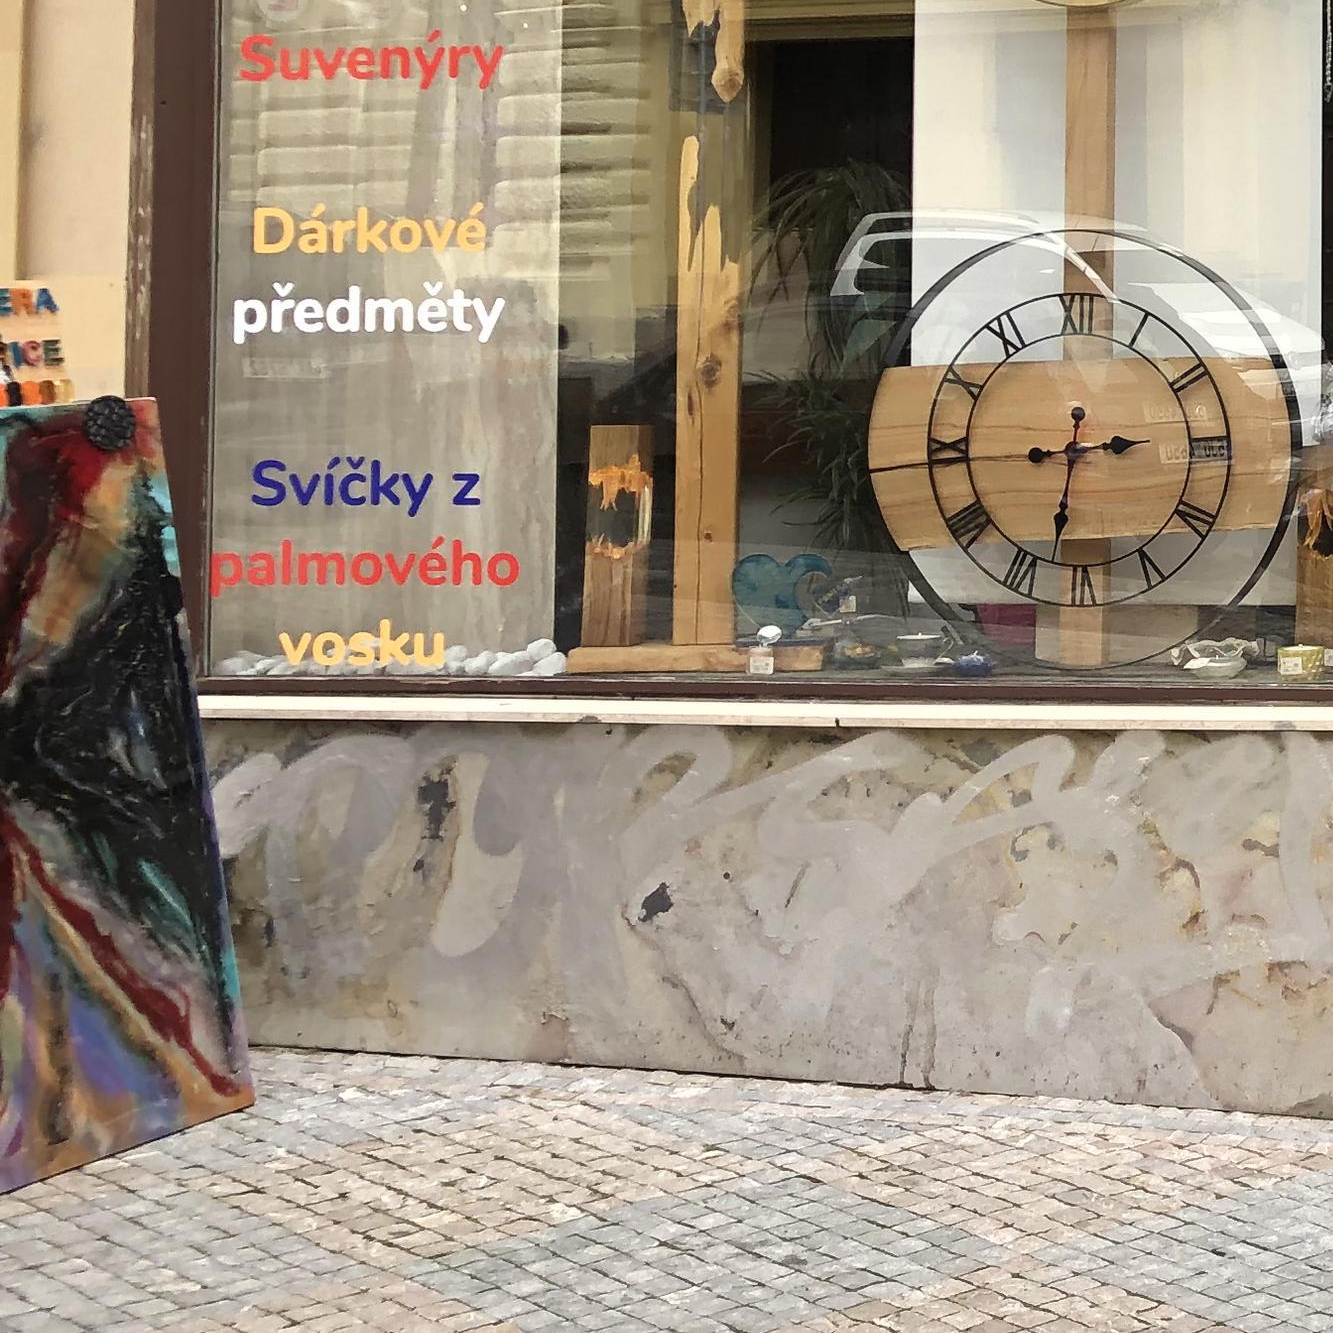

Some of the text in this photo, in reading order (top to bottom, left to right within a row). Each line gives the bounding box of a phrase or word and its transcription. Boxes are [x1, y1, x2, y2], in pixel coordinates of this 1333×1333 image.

[238, 28, 504, 91] Suvenýry
[252, 201, 488, 255] Dárkové
[232, 280, 507, 346] předměty
[250, 456, 482, 518] Svíčky z
[210, 538, 521, 598] palmového
[278, 617, 447, 667] vosku
